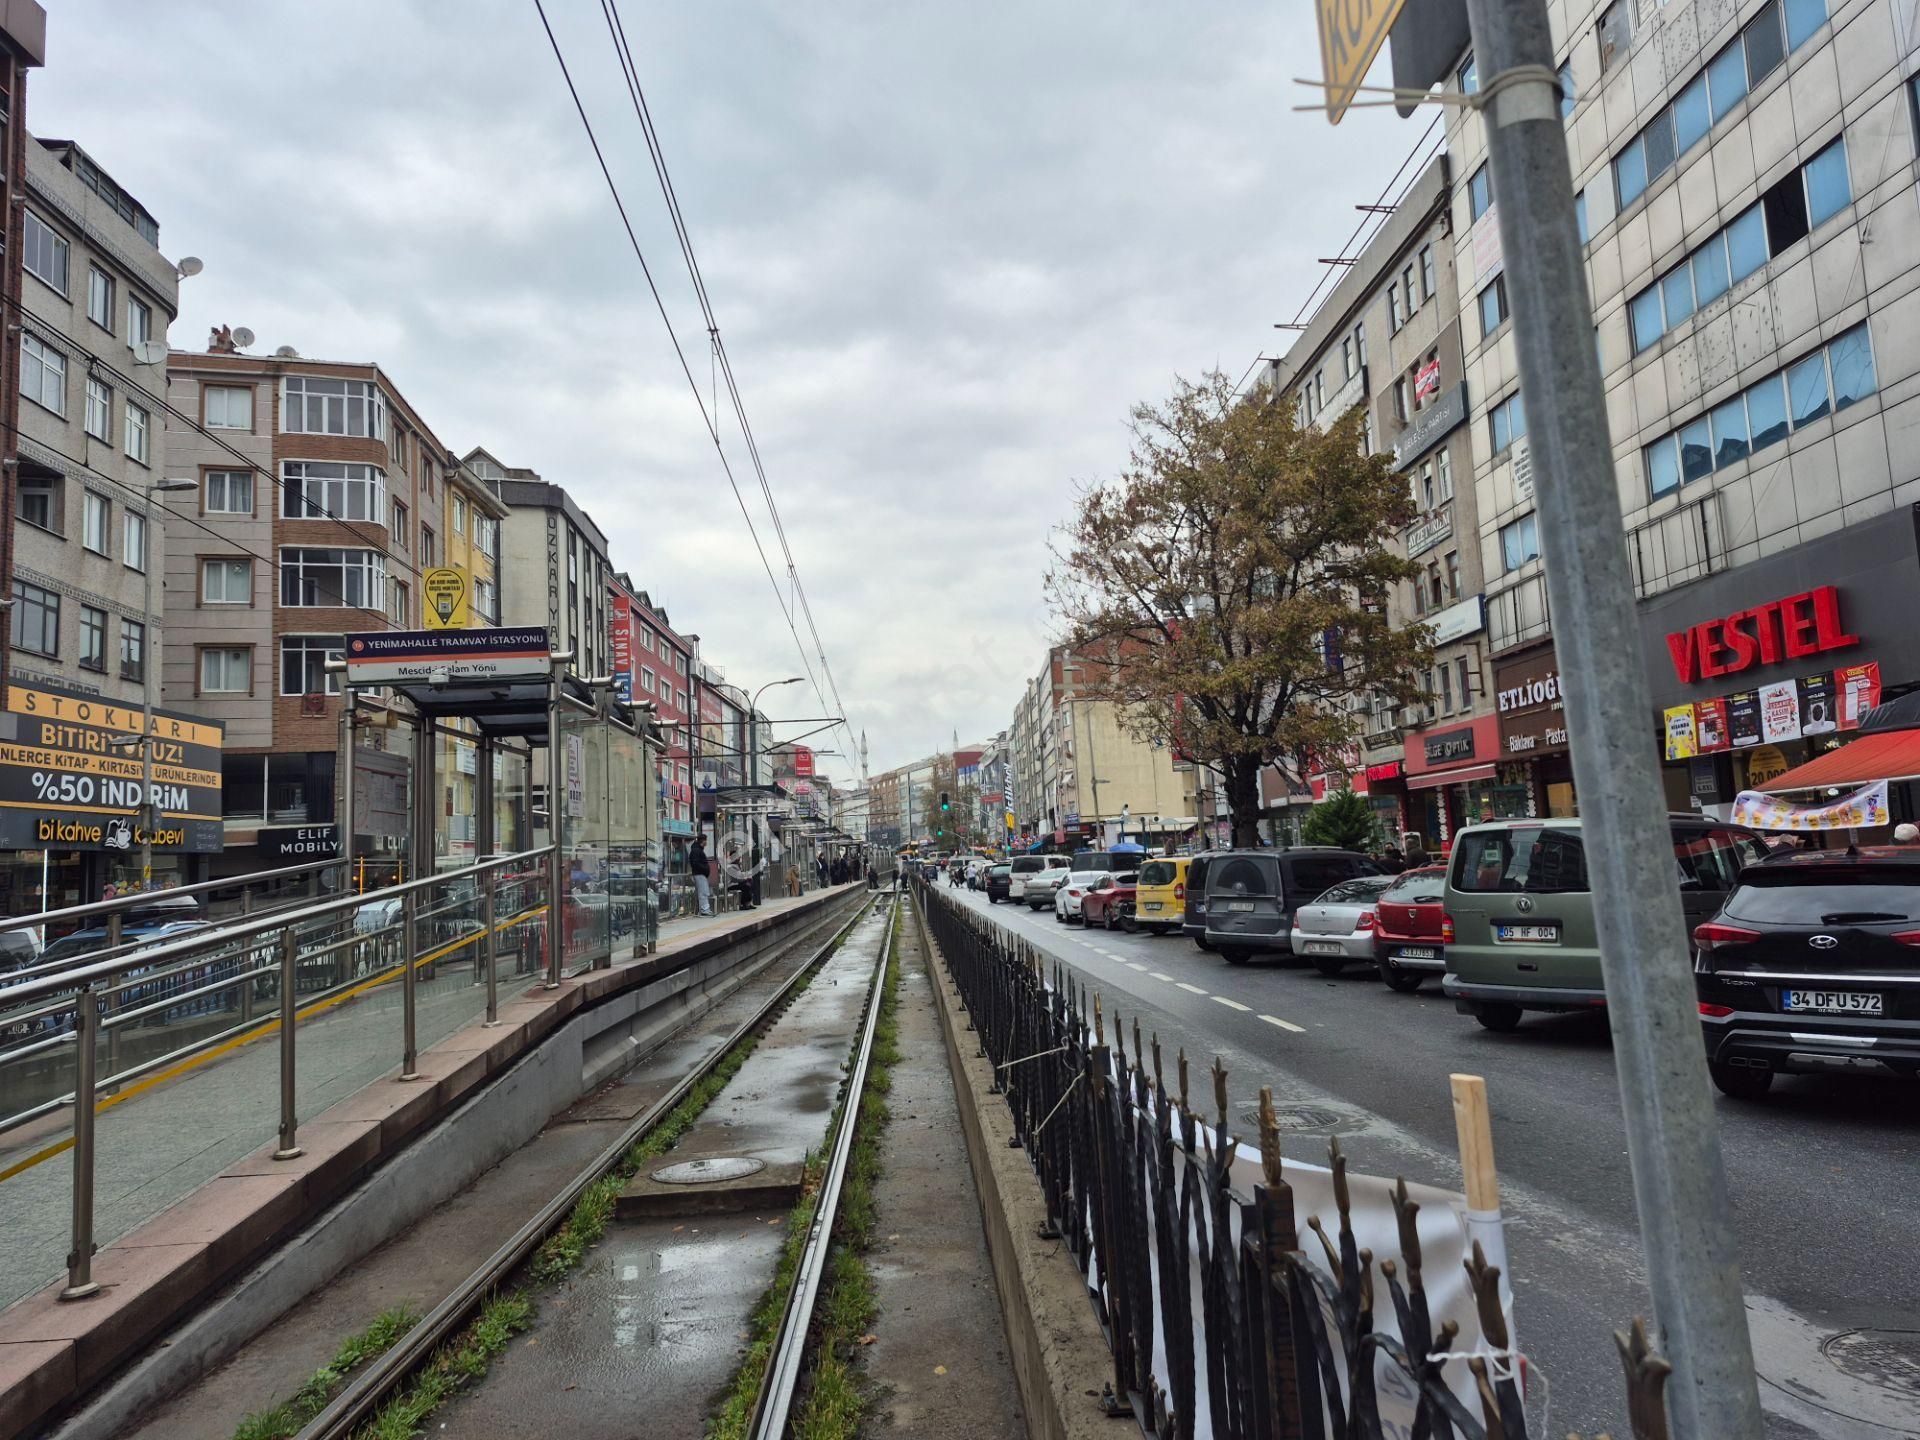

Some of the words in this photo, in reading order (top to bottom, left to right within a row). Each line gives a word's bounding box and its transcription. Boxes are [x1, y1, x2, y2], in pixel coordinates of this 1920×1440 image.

[368, 638, 438, 649] YENİMAHALLE
[441, 636, 487, 647] TRAMVAY
[489, 634, 544, 645] İSTASYONU
[614, 629, 629, 665] SINAV
[1665, 586, 1860, 684] VESTEL
[25, 692, 195, 740] STOKLARI
[32, 772, 94, 803] %50
[56, 819, 102, 842] kahve
[1521, 928, 1531, 937] HF
[1791, 992, 1811, 1006] 34
[1815, 993, 1847, 1008] DFU
[1850, 994, 1881, 1009] 572
